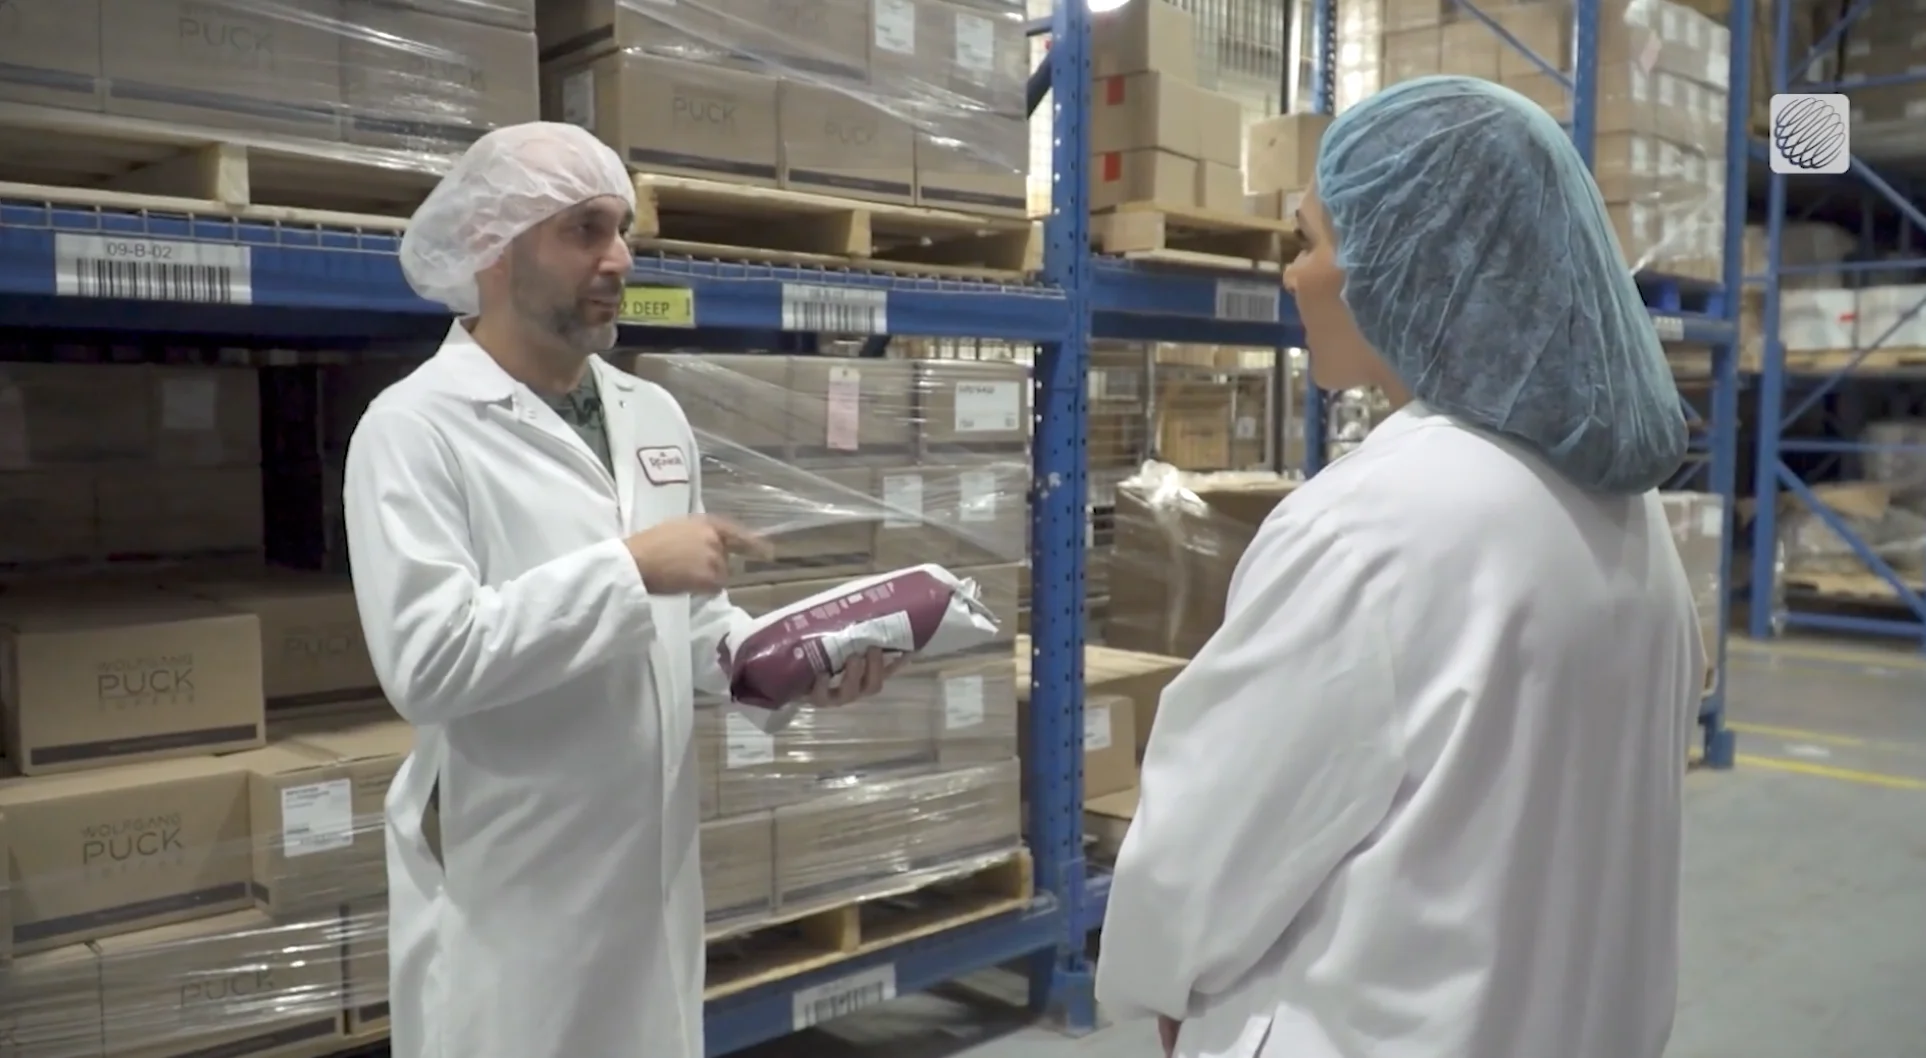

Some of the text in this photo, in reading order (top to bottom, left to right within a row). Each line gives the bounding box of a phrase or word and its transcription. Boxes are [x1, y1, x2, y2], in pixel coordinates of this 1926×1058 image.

[178, 17, 274, 55] PUCK
[673, 96, 737, 126] PUCK
[107, 242, 173, 259] 09-B-02
[633, 301, 670, 316] DEEP
[98, 667, 194, 699] PUCK
[83, 827, 185, 865] PUCK
[181, 970, 274, 1006] PUCK
